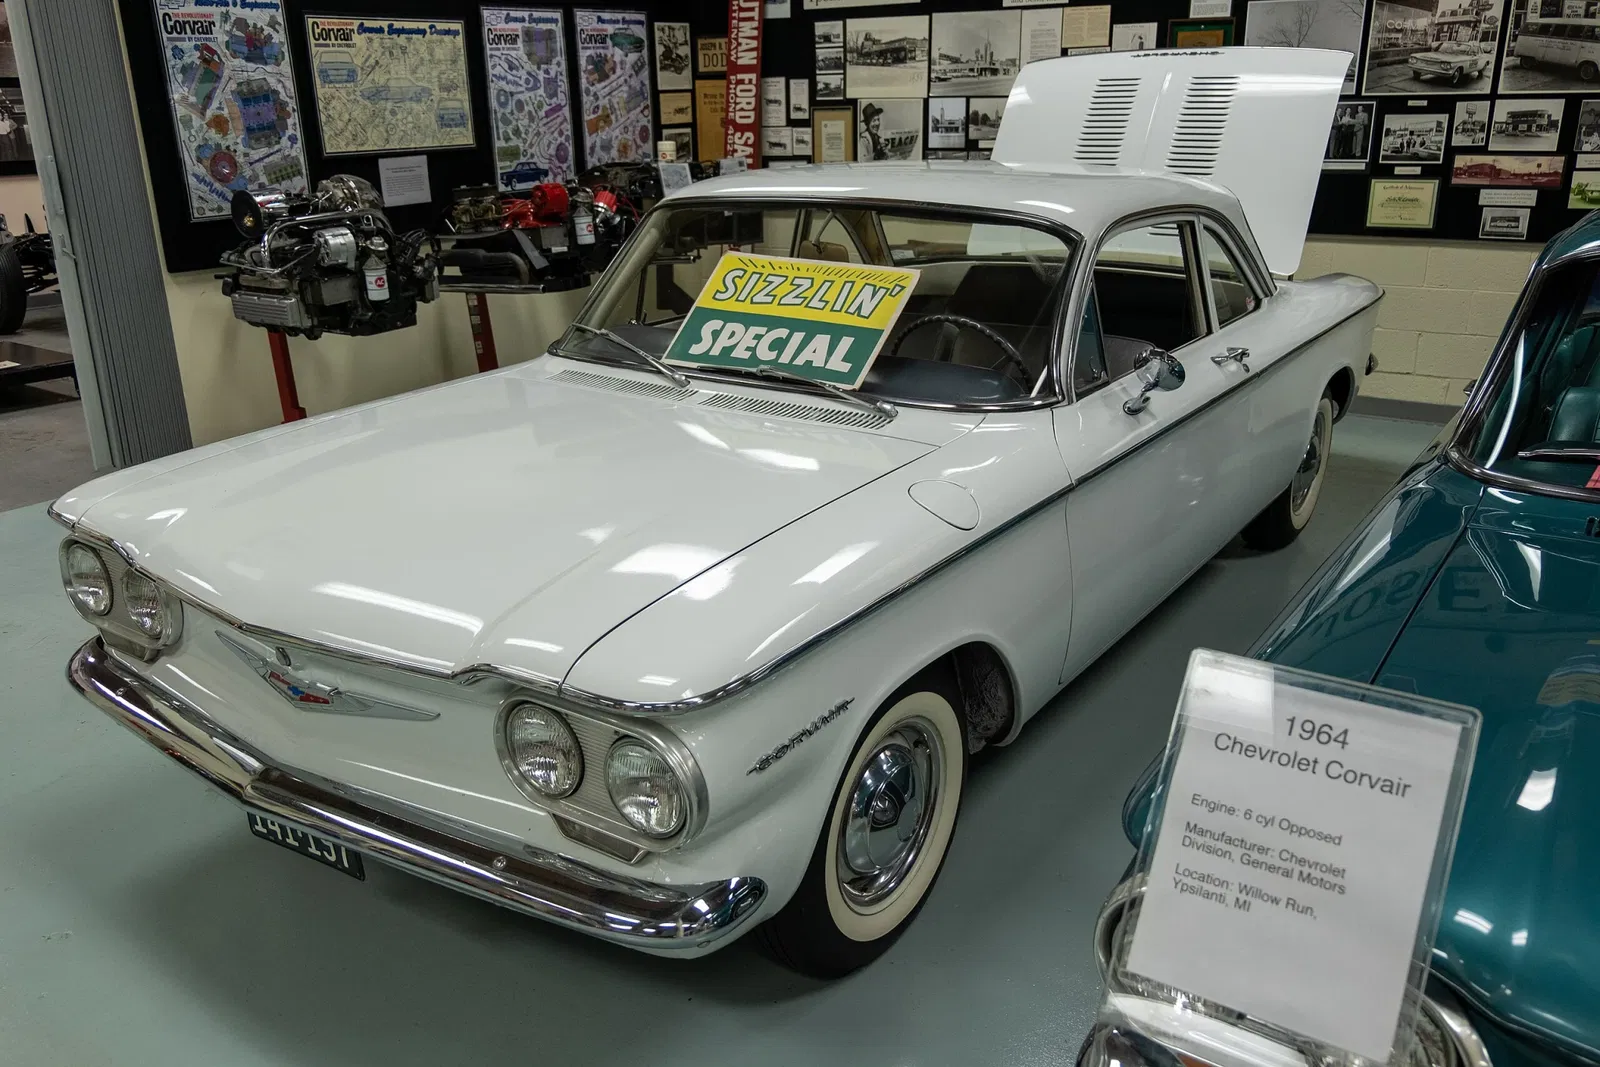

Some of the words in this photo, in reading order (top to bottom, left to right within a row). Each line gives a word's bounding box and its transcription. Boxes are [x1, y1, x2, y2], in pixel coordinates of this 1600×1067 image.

[162, 12, 216, 35] Corvair
[311, 21, 355, 42] Corvair
[487, 28, 520, 46] Corvair
[579, 28, 608, 45] Corvair
[730, 0, 739, 62] HTENAW
[728, 75, 736, 120] PHONE
[735, 73, 757, 124] FORD
[726, 125, 735, 158] 482-
[713, 267, 906, 319] SIZZLIN'
[689, 319, 855, 373] SPECIAL
[1285, 715, 1350, 750] 1964
[1214, 732, 1320, 775] Chevrolet
[1325, 760, 1412, 798] Corvair
[1191, 793, 1240, 818] Engine:
[1243, 808, 1253, 821] 6
[1256, 812, 1275, 828] cyl
[1279, 818, 1343, 846] Opposed
[1182, 835, 1235, 863] Division,
[1240, 852, 1294, 879] General
[1297, 868, 1346, 895] Motors
[1185, 821, 1276, 858] Manufacturer:
[1279, 848, 1346, 879] Chevrolet
[1172, 877, 1229, 907] Ypsilanti,
[1234, 896, 1252, 912] MI
[1175, 863, 1234, 891] Location:
[1238, 882, 1282, 907] Willow
[1284, 895, 1318, 920] Run,
